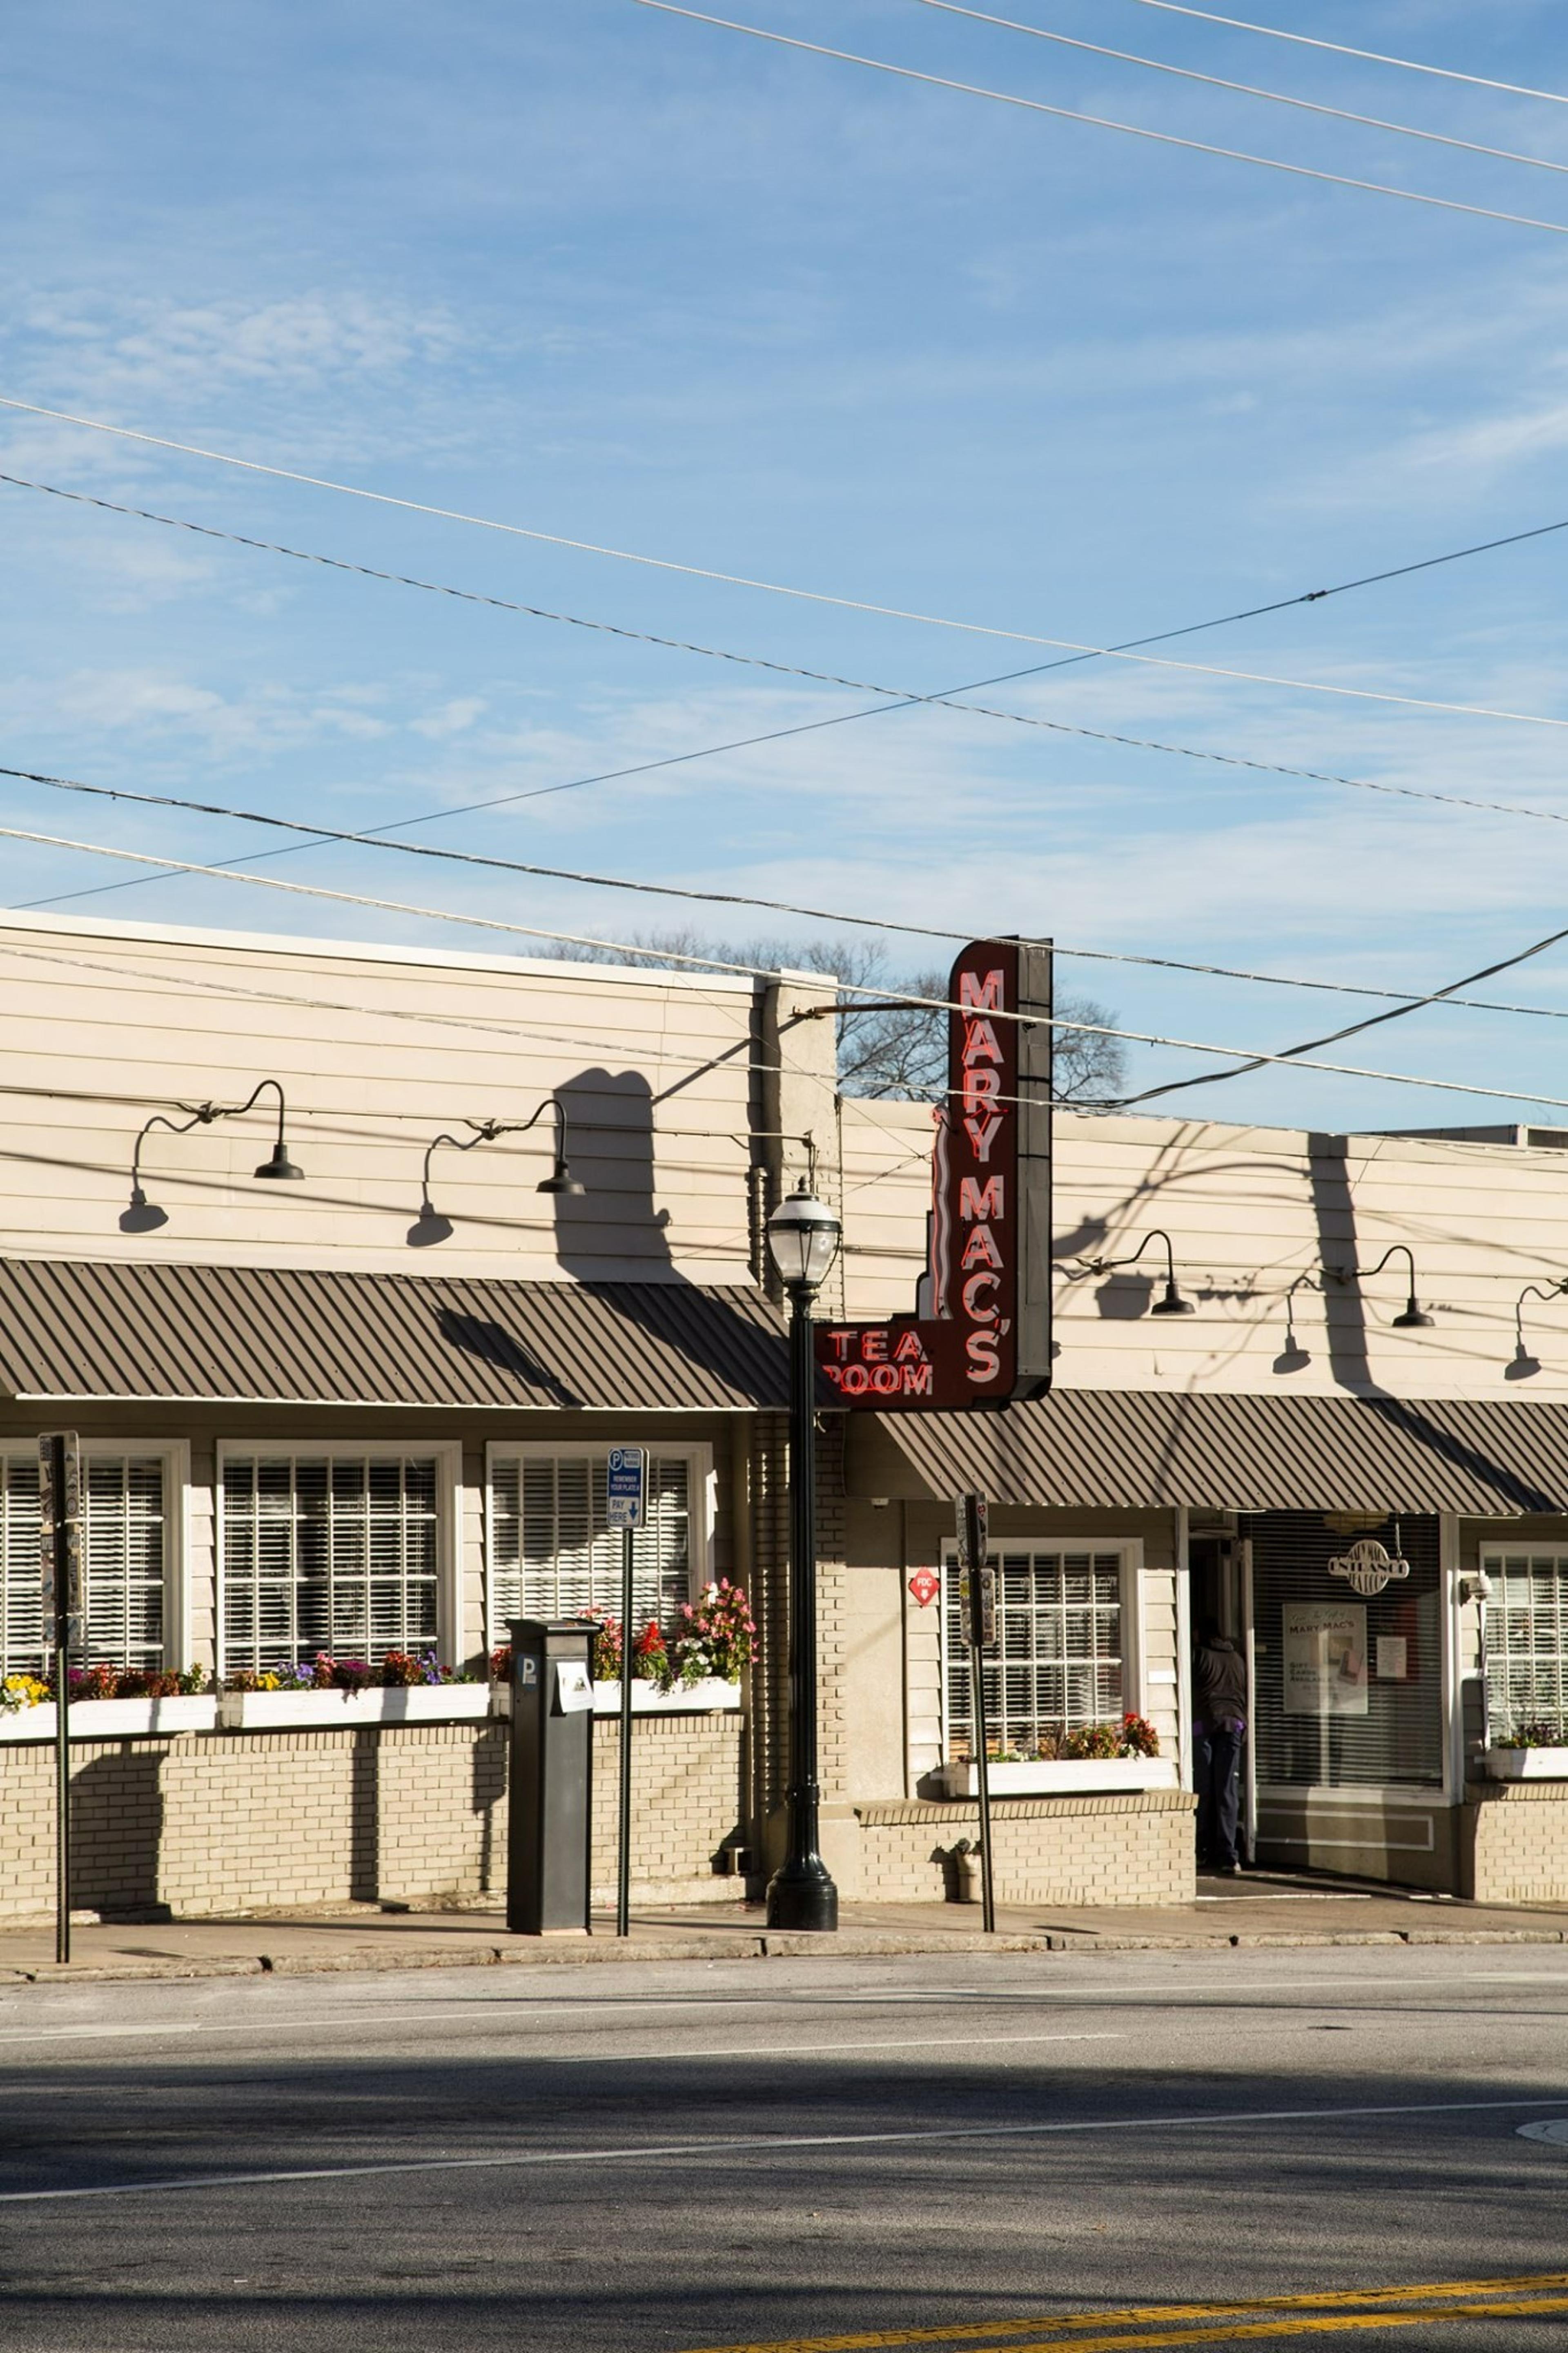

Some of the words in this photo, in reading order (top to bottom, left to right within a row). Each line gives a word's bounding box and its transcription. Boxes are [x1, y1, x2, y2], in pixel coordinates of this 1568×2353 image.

[960, 970, 1004, 1162] MARY
[960, 1175, 1011, 1383] MAC'S
[827, 1331, 928, 1361] TEA
[613, 1453, 620, 1466] P
[612, 1499, 625, 1509] PAY
[608, 1512, 627, 1522] HERE
[1330, 1561, 1403, 1573] ENTRANCE
[917, 1577, 932, 1587] FDC
[1290, 1625, 1319, 1634] MARY
[1323, 1620, 1354, 1630] MAC'S
[523, 1658, 535, 1684] P
